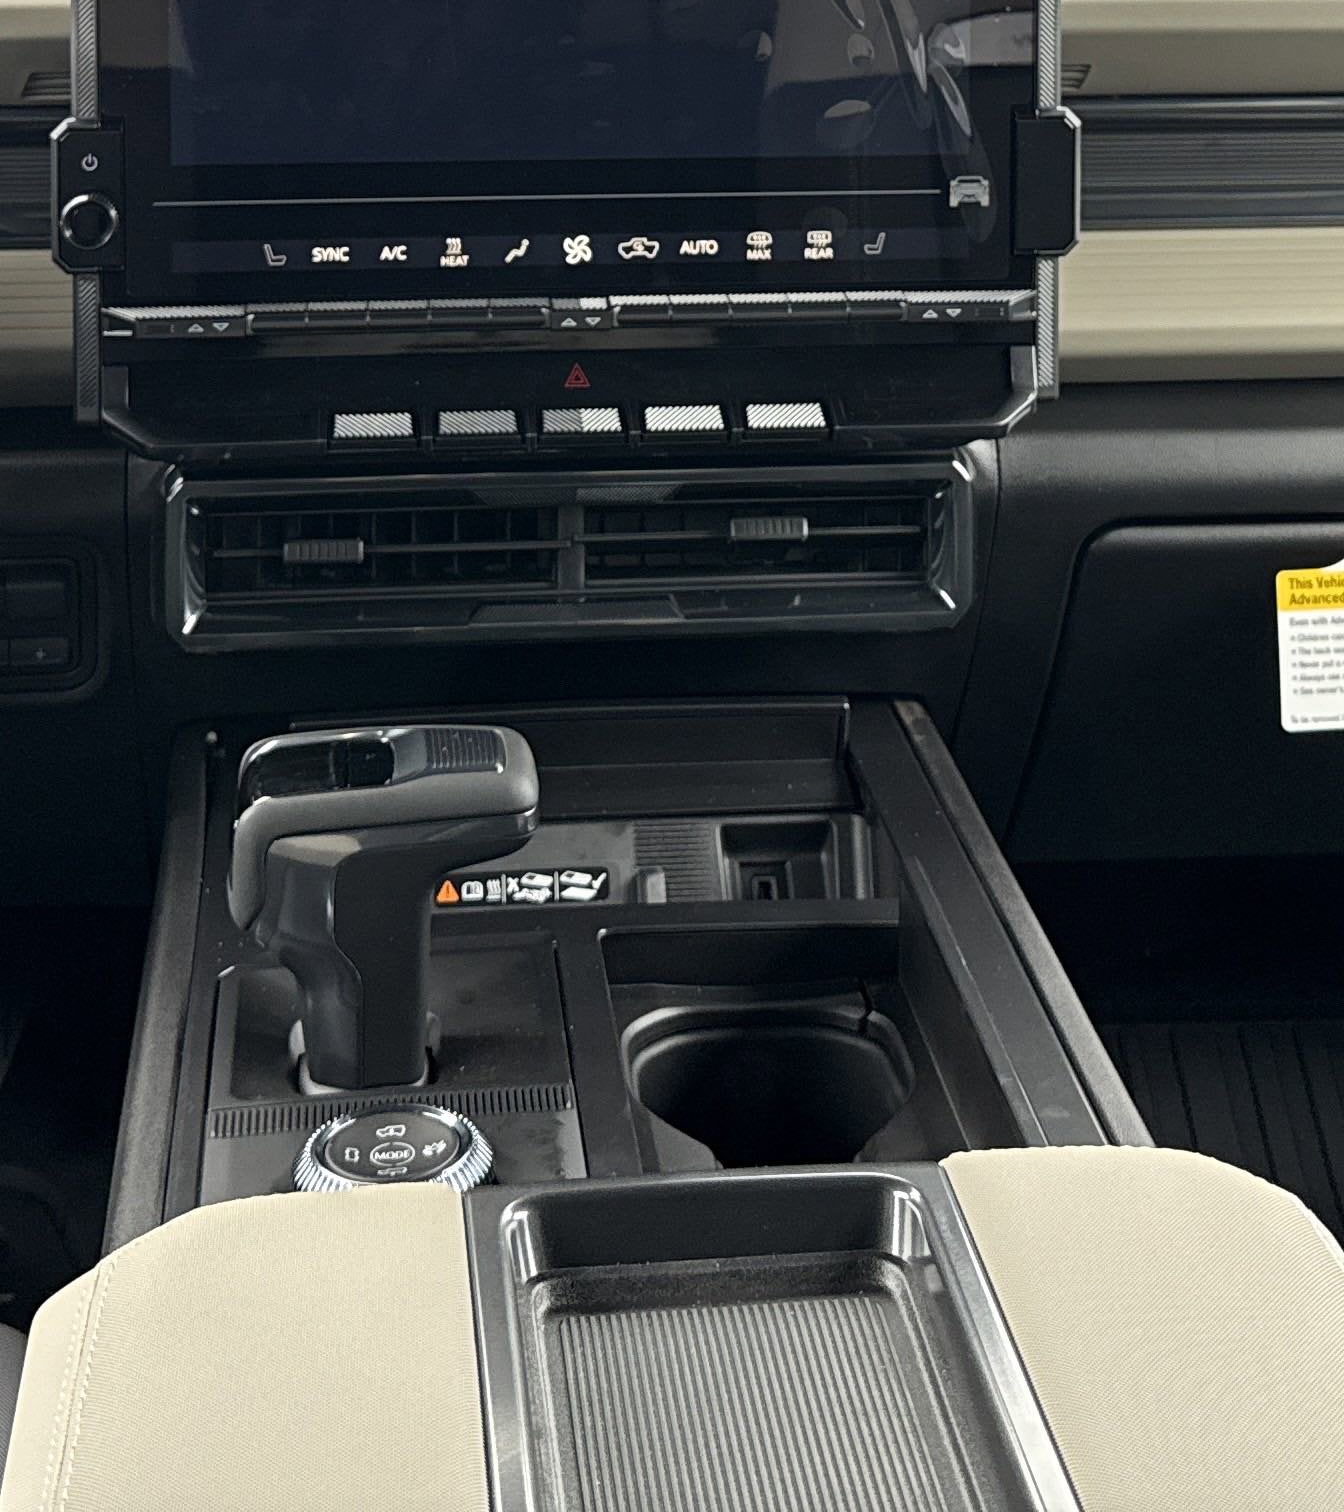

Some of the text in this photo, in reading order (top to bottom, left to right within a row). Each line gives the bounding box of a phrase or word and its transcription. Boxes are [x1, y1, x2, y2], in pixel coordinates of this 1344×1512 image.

[311, 245, 407, 263] SYNC A/C
[679, 239, 719, 256] AUTO
[746, 248, 772, 260] MAX
[804, 247, 834, 260] REAR
[440, 255, 469, 267] HEAT
[1288, 577, 1313, 590] This
[374, 1149, 411, 1160] MODE
